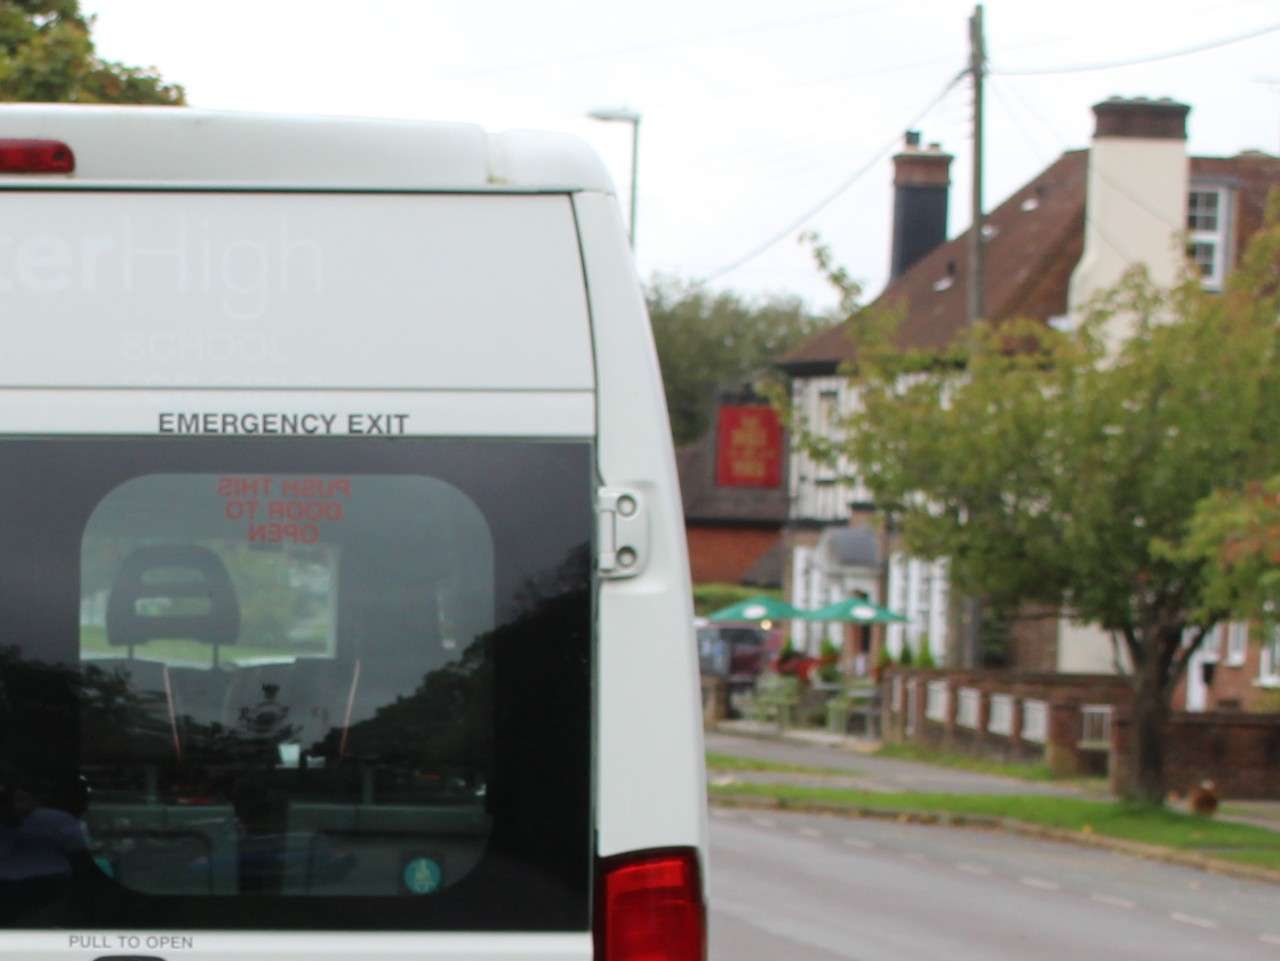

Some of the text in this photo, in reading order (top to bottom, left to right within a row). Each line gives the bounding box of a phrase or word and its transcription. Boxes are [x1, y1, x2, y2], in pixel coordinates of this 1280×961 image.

[158, 412, 410, 435] EMERGENCY EXIT
[68, 934, 194, 950] PULL TO OPEN
